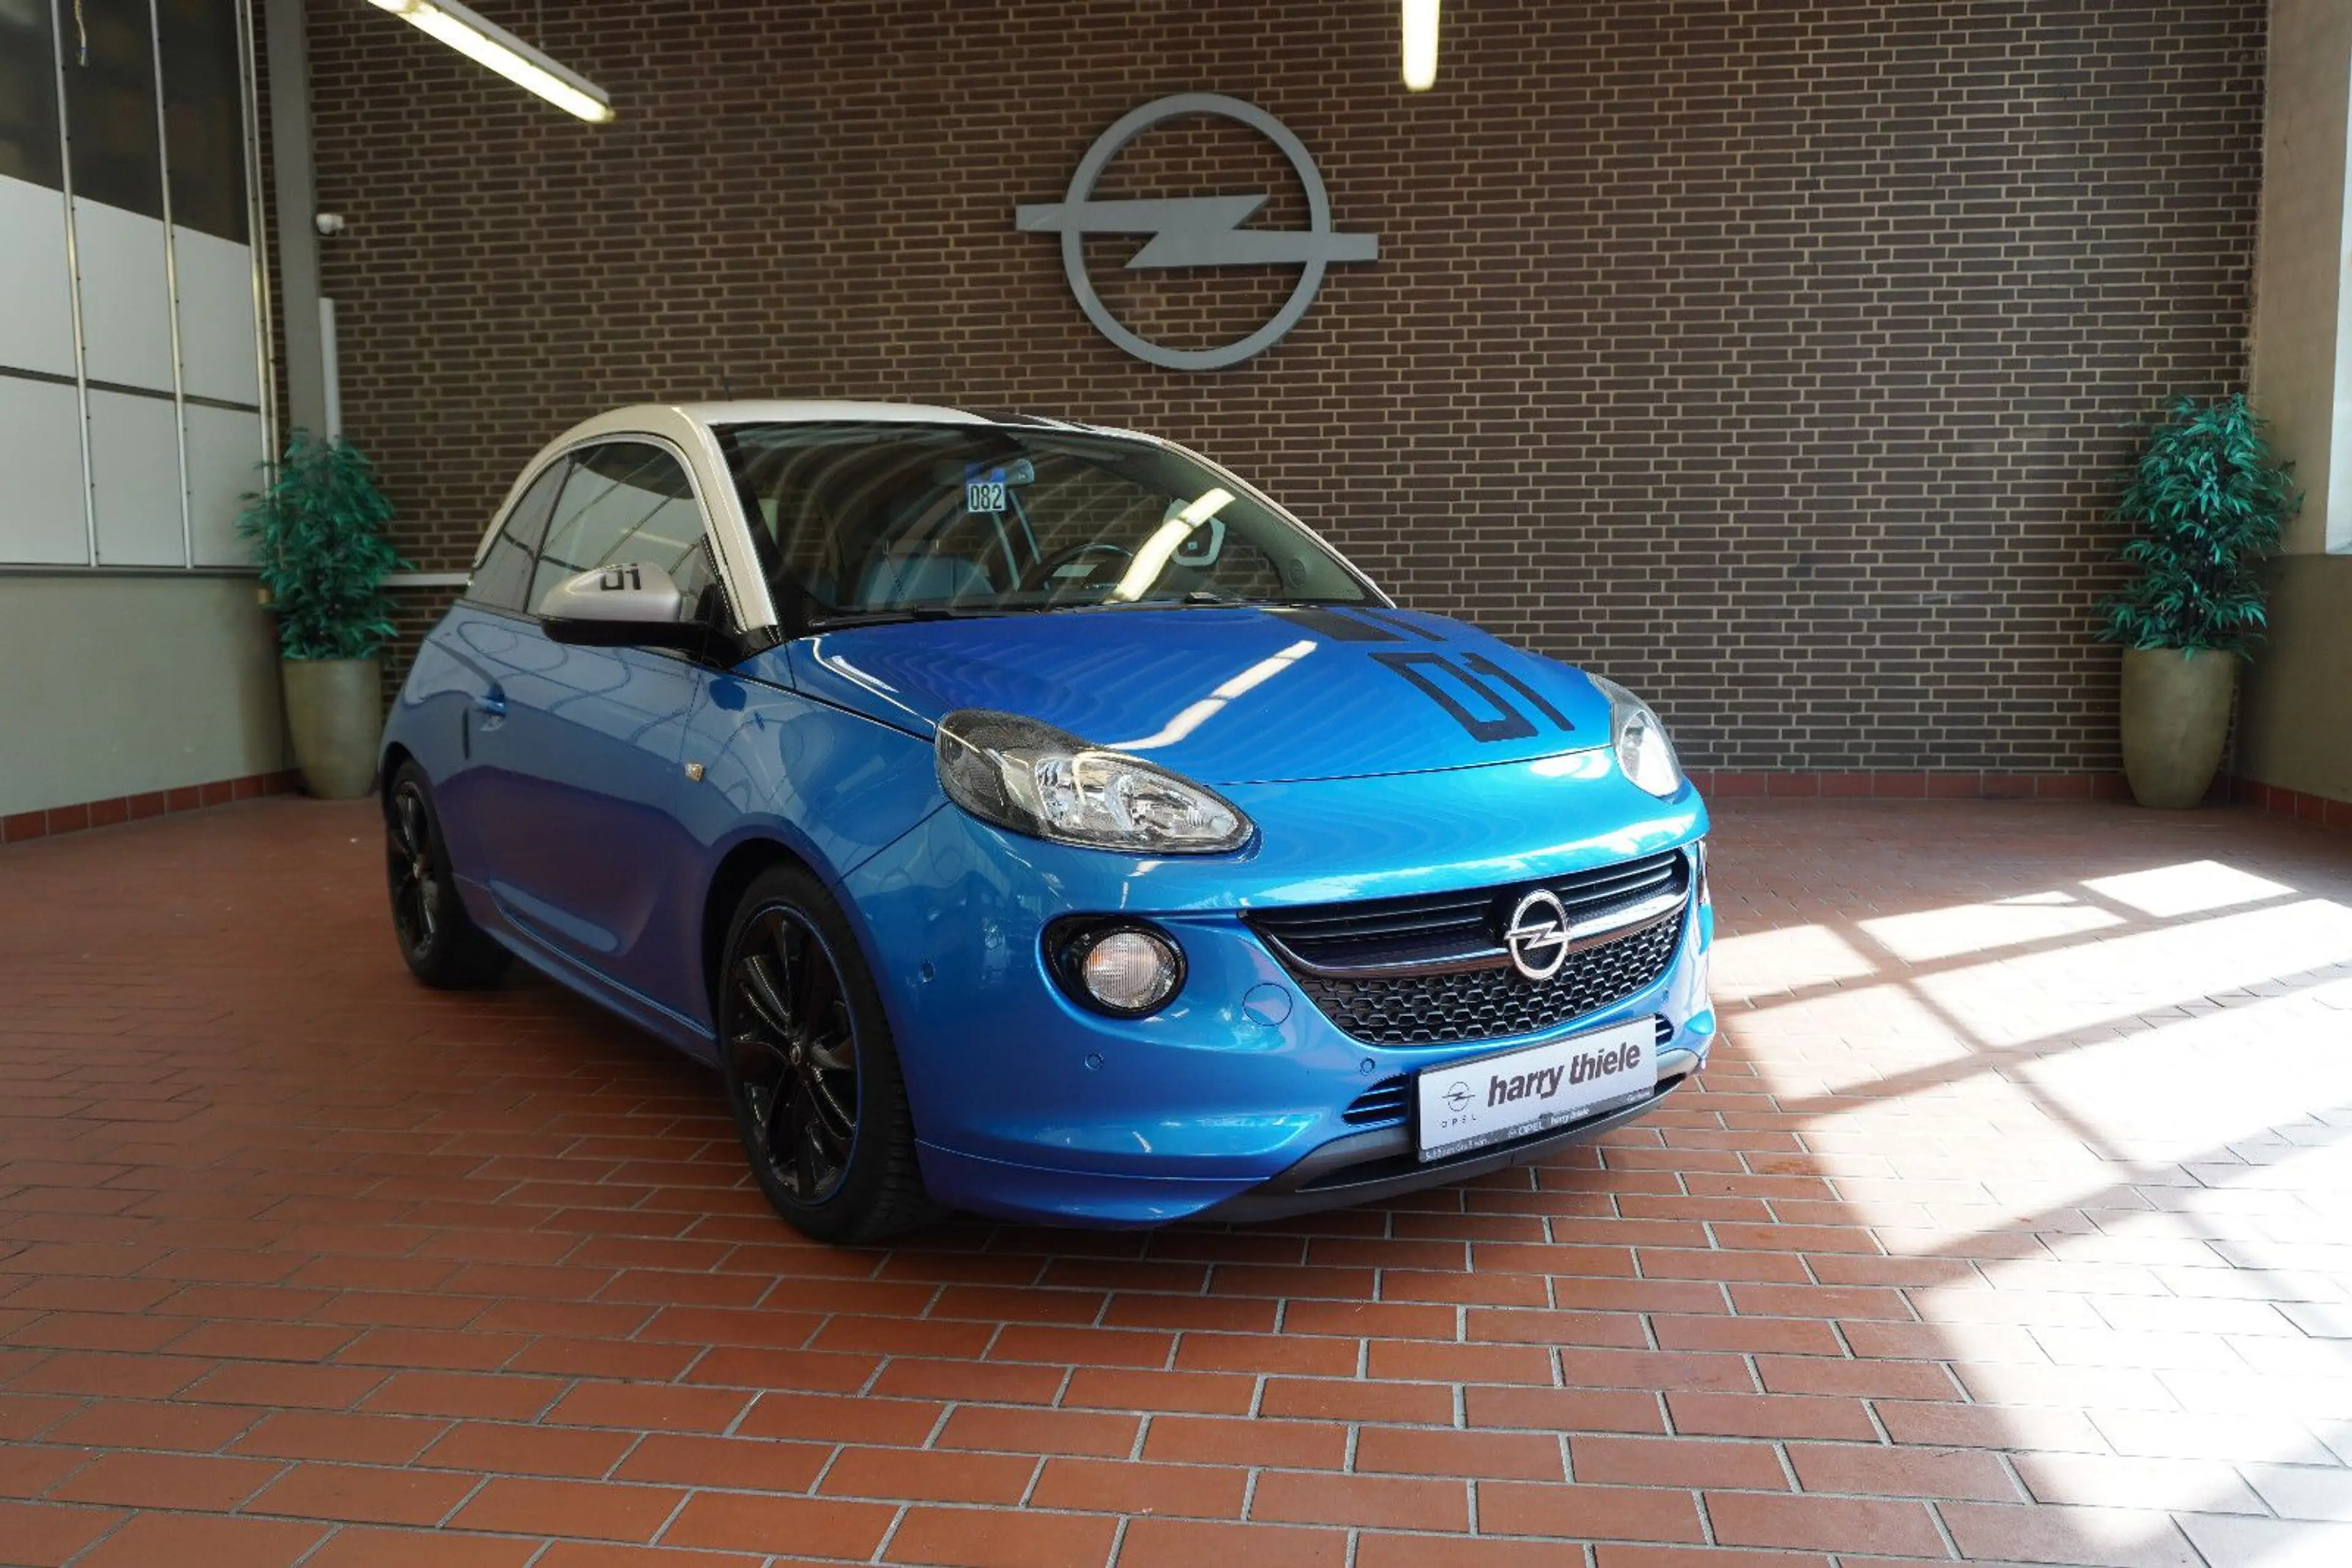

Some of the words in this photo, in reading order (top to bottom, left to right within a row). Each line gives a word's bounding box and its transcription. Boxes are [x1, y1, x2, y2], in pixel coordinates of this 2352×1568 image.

[970, 483, 1003, 510] 082
[1487, 1065, 1564, 1107] harry
[1569, 1042, 1640, 1085] thiele
[1518, 1121, 1544, 1136] OPEL
